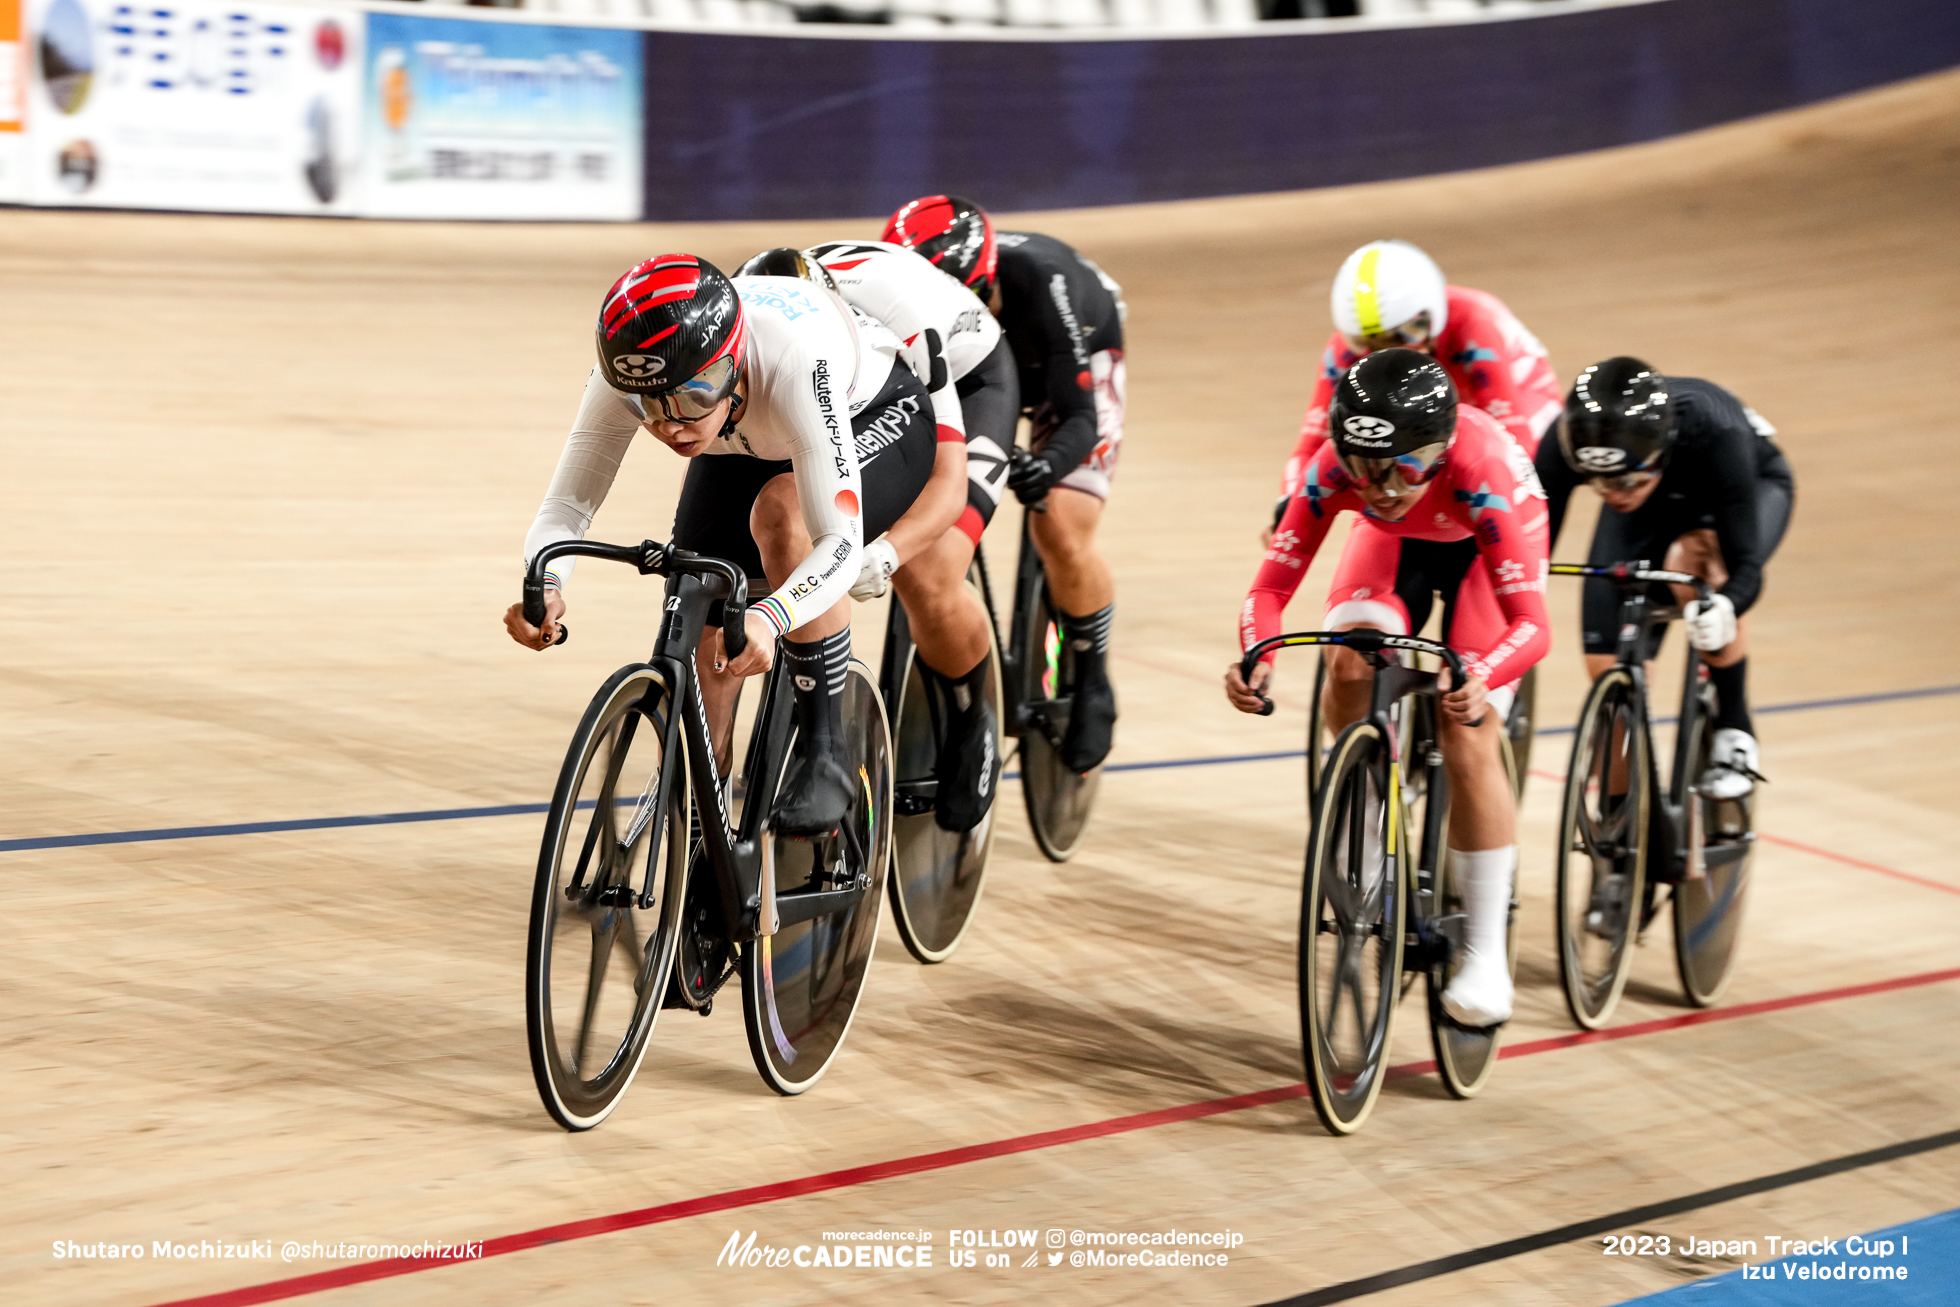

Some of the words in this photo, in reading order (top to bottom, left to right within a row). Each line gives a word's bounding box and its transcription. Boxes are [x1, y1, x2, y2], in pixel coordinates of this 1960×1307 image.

[616, 374, 668, 387] Kabuto
[816, 359, 833, 413] Rakuten
[823, 414, 850, 479] Kドリームス
[832, 537, 853, 565] KEIRIN
